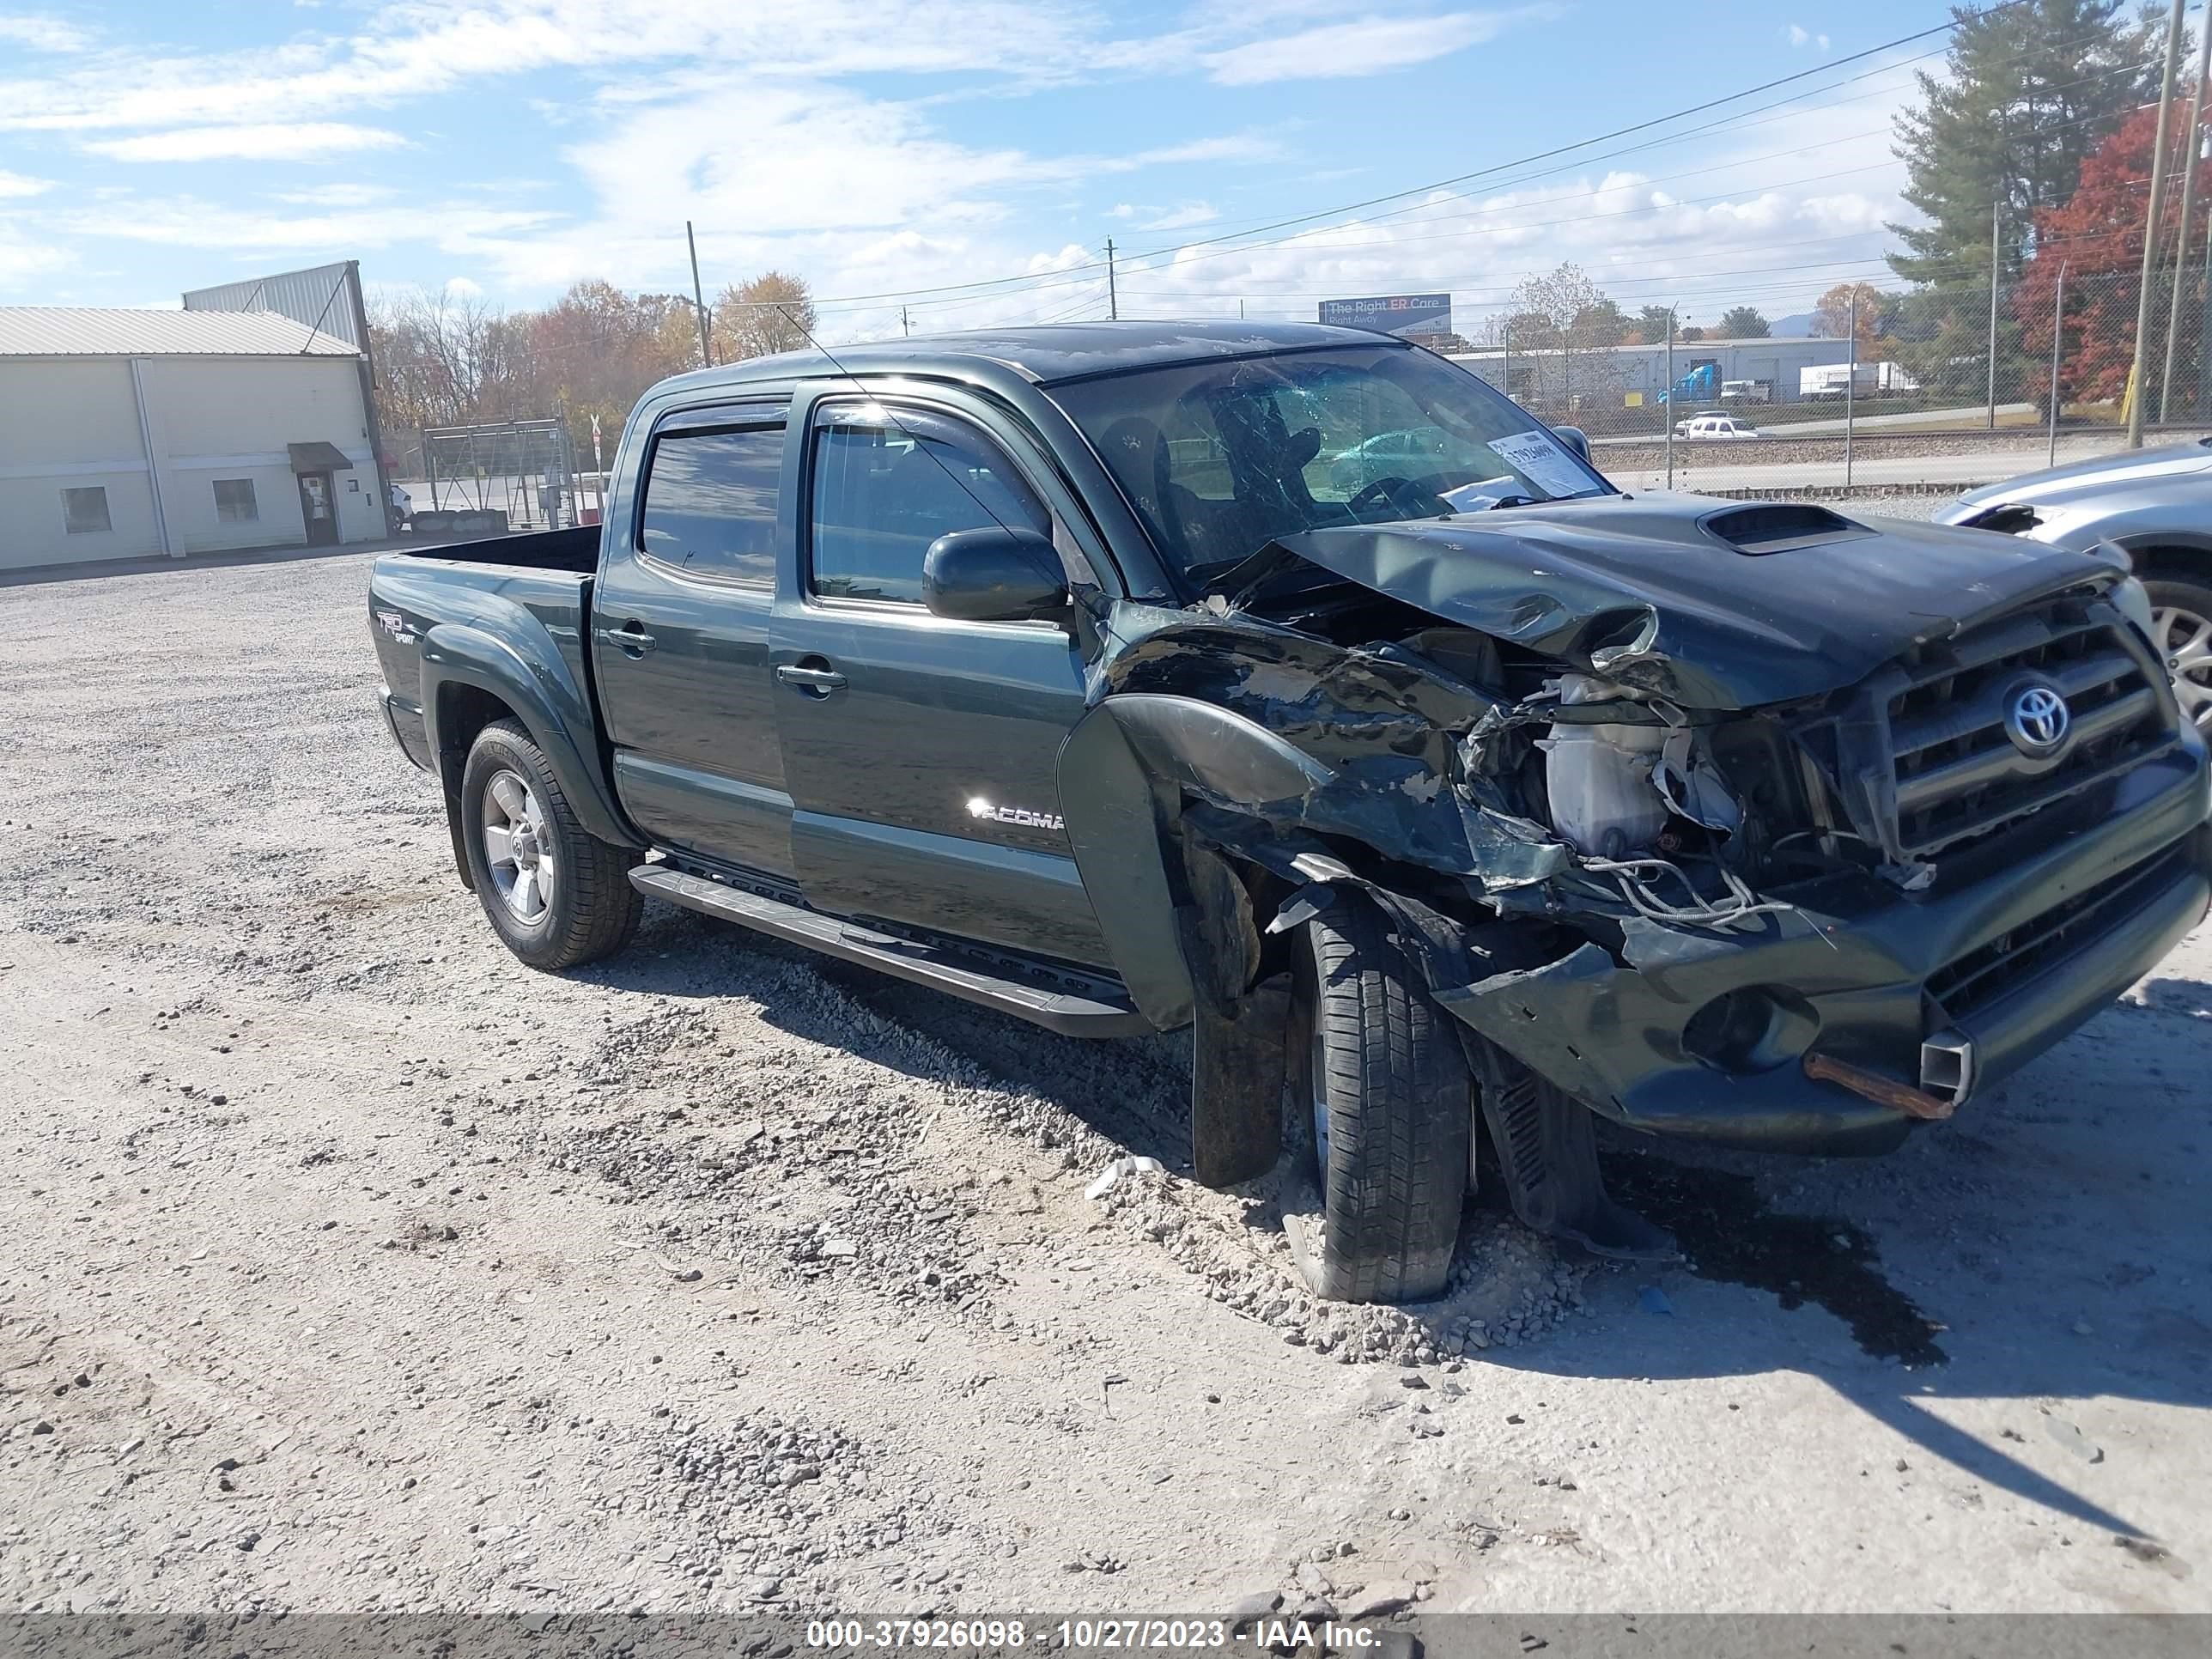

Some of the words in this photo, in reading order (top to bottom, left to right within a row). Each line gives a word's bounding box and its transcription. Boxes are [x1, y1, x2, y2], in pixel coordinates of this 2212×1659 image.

[1330, 302, 1352, 314] The
[1355, 301, 1387, 315] Right
[1390, 299, 1407, 310] ER
[1410, 297, 1439, 309] Care
[1330, 314, 1352, 324] Right
[1354, 315, 1377, 324] Away
[1507, 444, 1556, 463] 37926098
[377, 611, 403, 635] TRD
[395, 633, 415, 646] SPORT
[963, 798, 1066, 830] TACOMA
